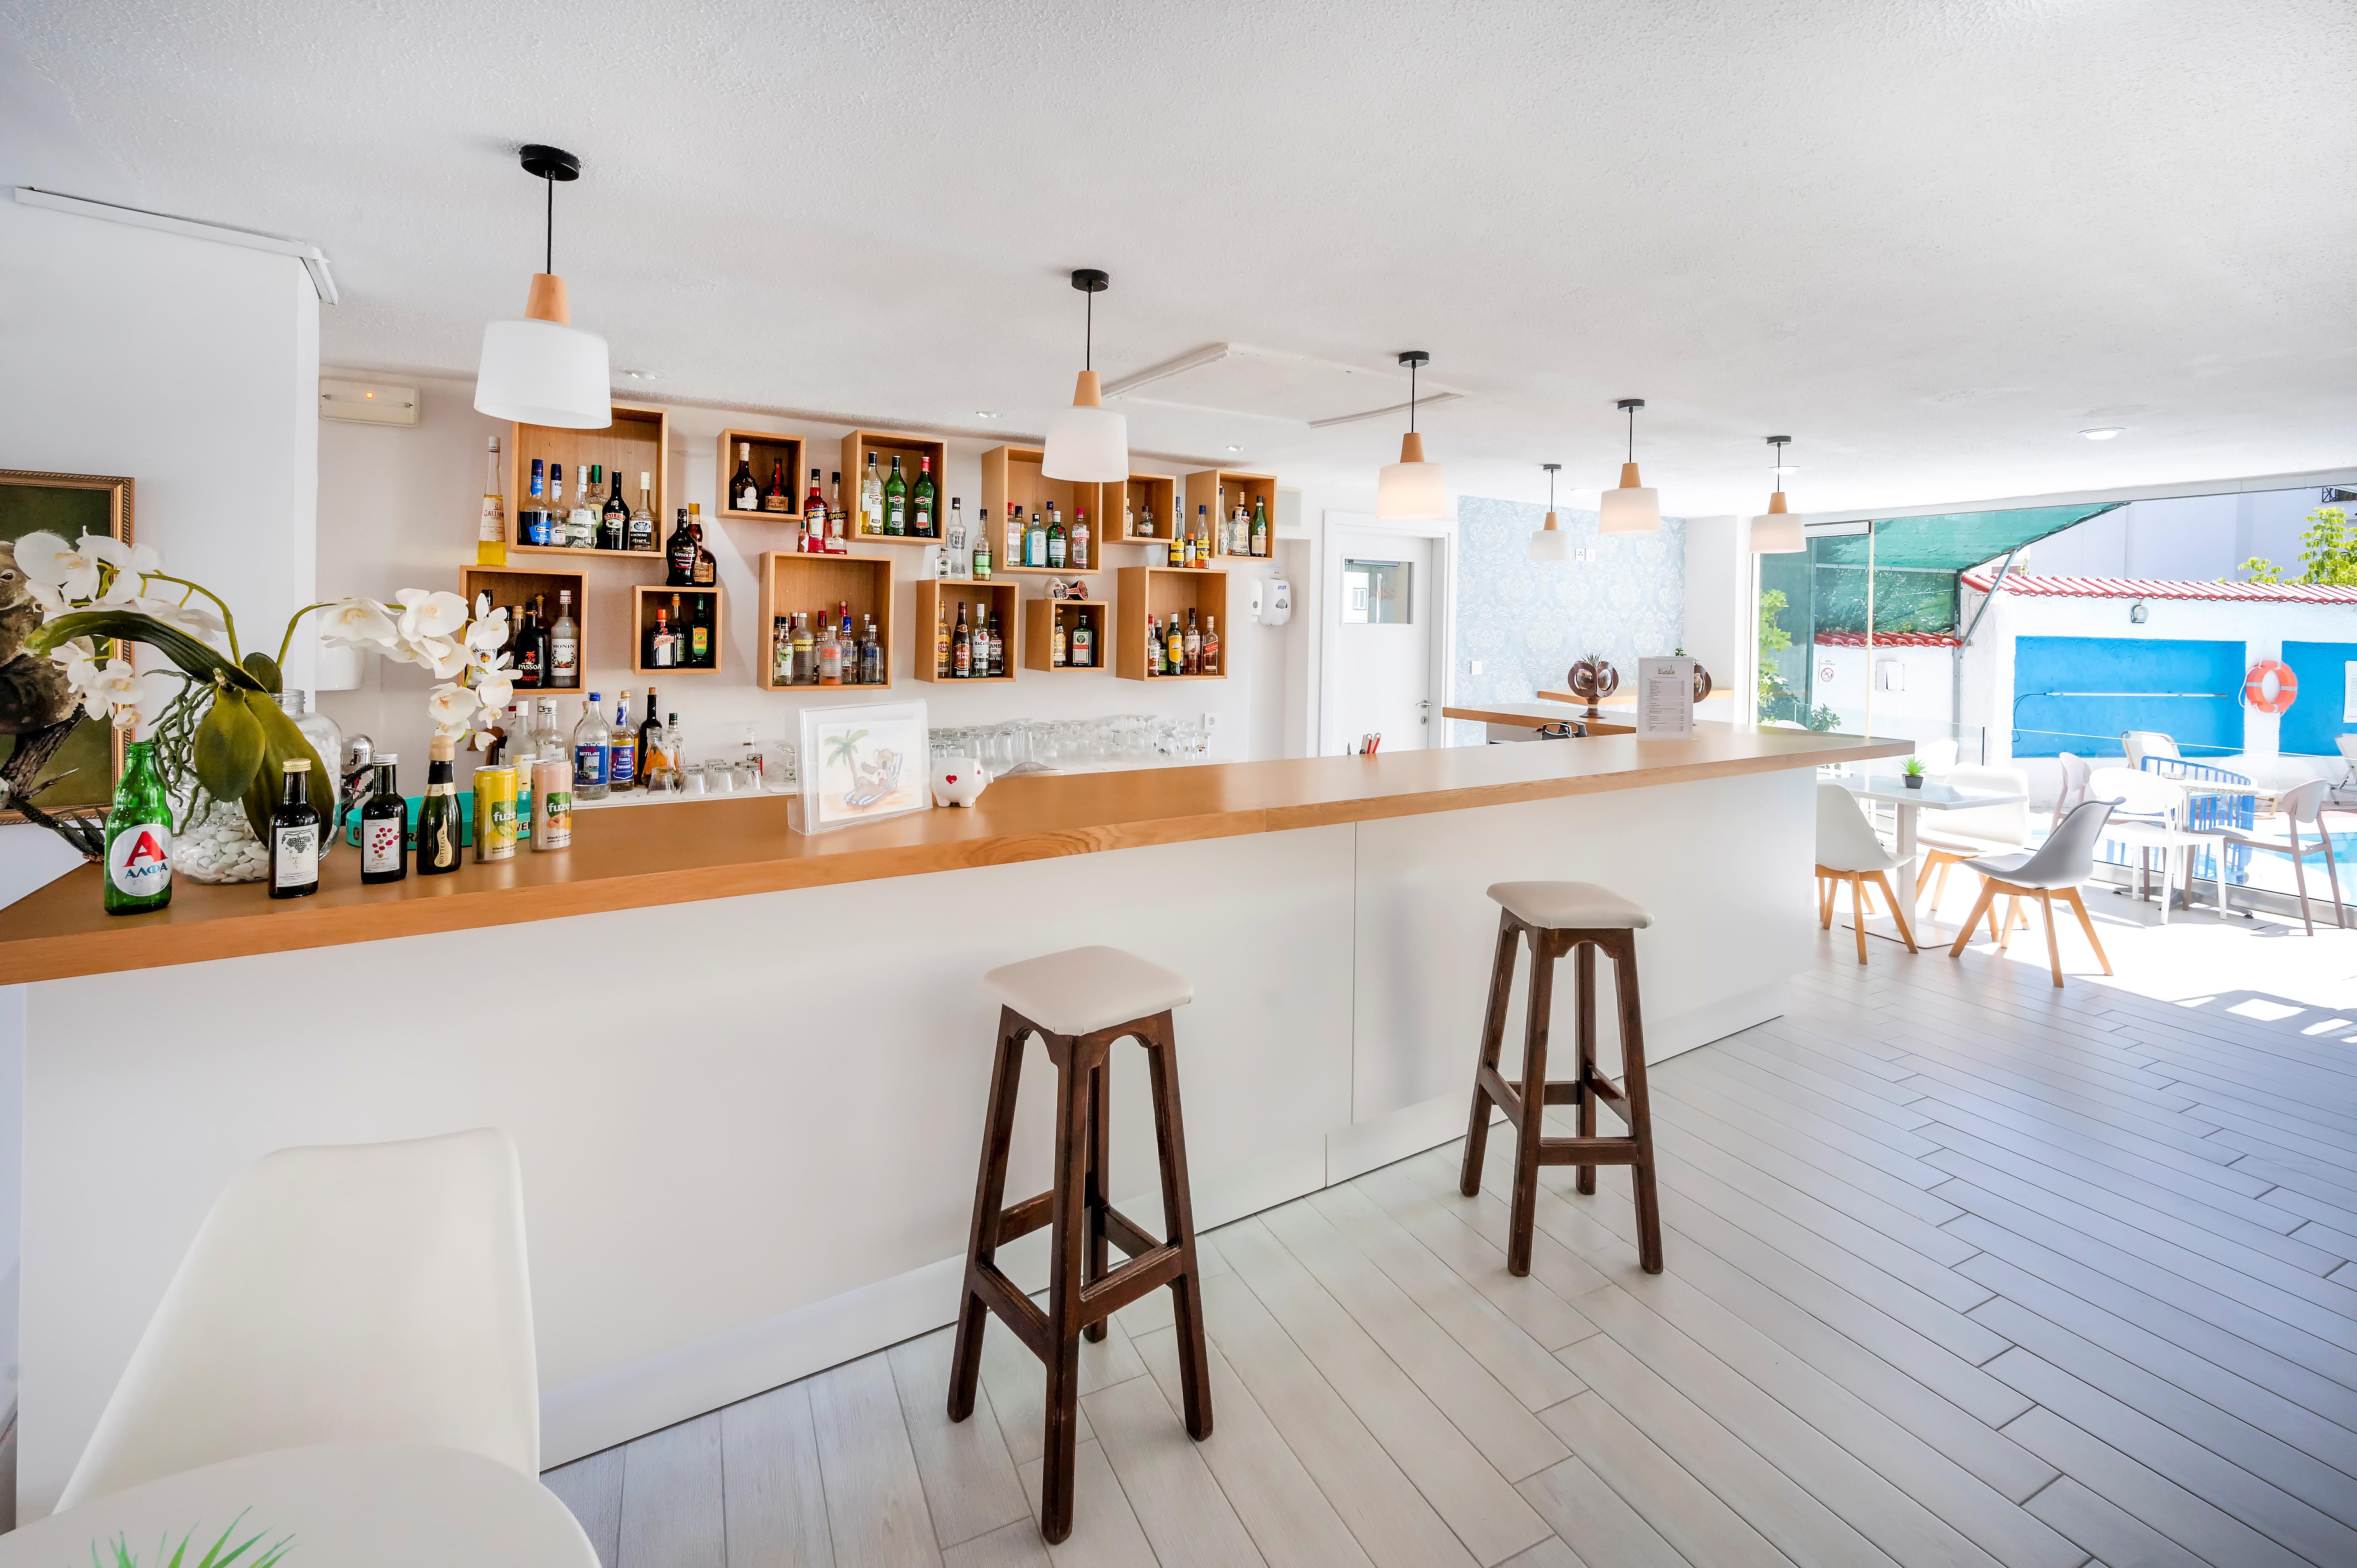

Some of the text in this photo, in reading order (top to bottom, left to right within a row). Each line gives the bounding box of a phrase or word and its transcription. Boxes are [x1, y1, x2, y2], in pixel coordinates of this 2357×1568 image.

[1658, 665, 1675, 673] Koala
[548, 802, 570, 812] fuze
[493, 811, 516, 822] fuze
[125, 862, 168, 879] ΑΛΦΑ
